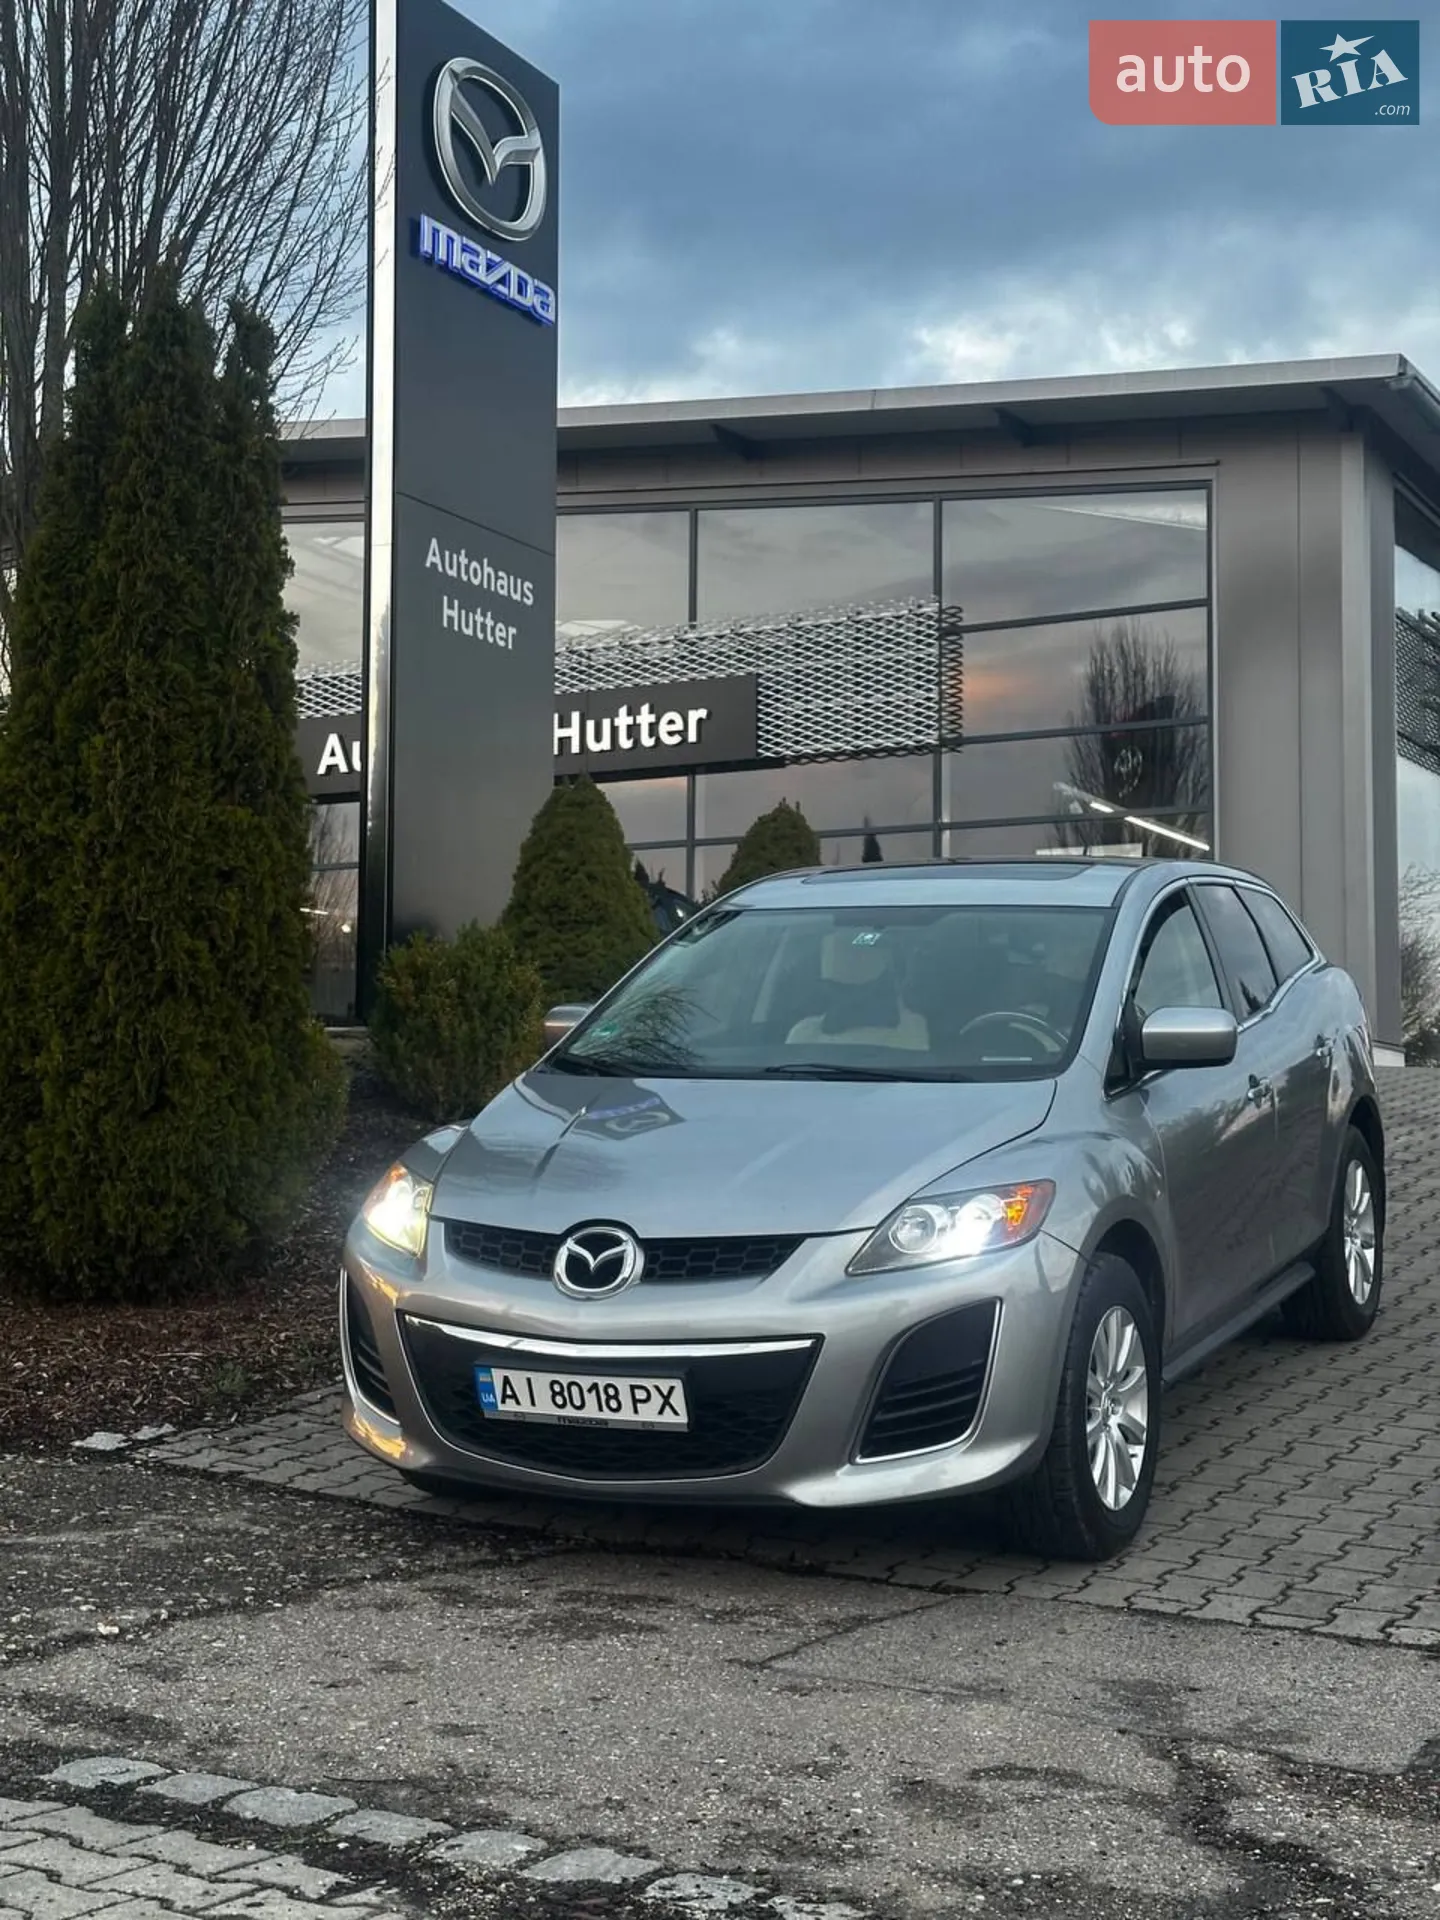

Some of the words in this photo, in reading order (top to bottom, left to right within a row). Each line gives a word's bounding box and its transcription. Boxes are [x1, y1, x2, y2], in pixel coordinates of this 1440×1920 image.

[425, 537, 535, 607] Autohaus
[442, 595, 517, 650] Hutter
[554, 702, 709, 755] Hutter
[500, 1375, 537, 1407] AI
[549, 1379, 623, 1414] 8018
[629, 1384, 680, 1416] PX
